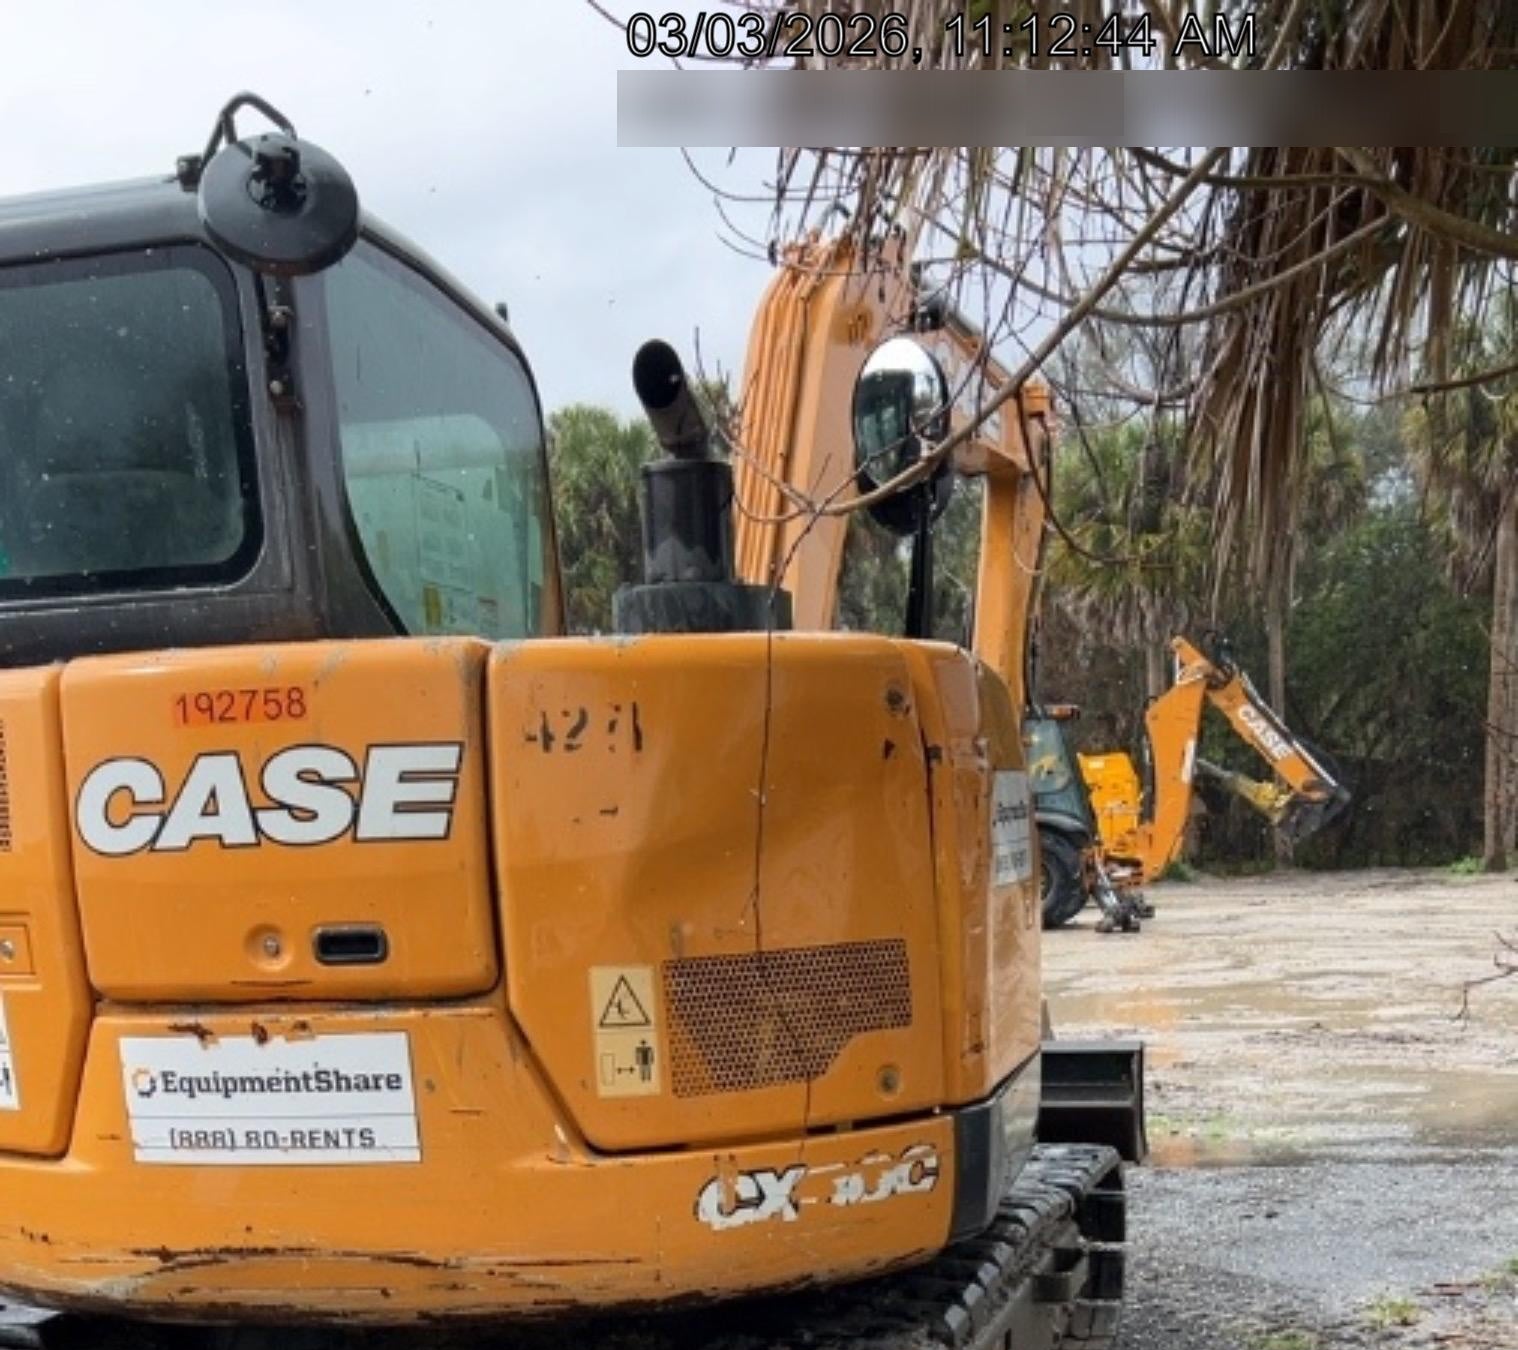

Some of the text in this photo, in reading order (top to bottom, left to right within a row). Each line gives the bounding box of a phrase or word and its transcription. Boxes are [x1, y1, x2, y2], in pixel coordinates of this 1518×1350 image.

[175, 686, 308, 724] 192758
[1239, 703, 1293, 760] CASE
[76, 742, 462, 857] CASE
[161, 1069, 402, 1098] EquipmentShare
[170, 1127, 376, 1151] (888) 80-RENTS
